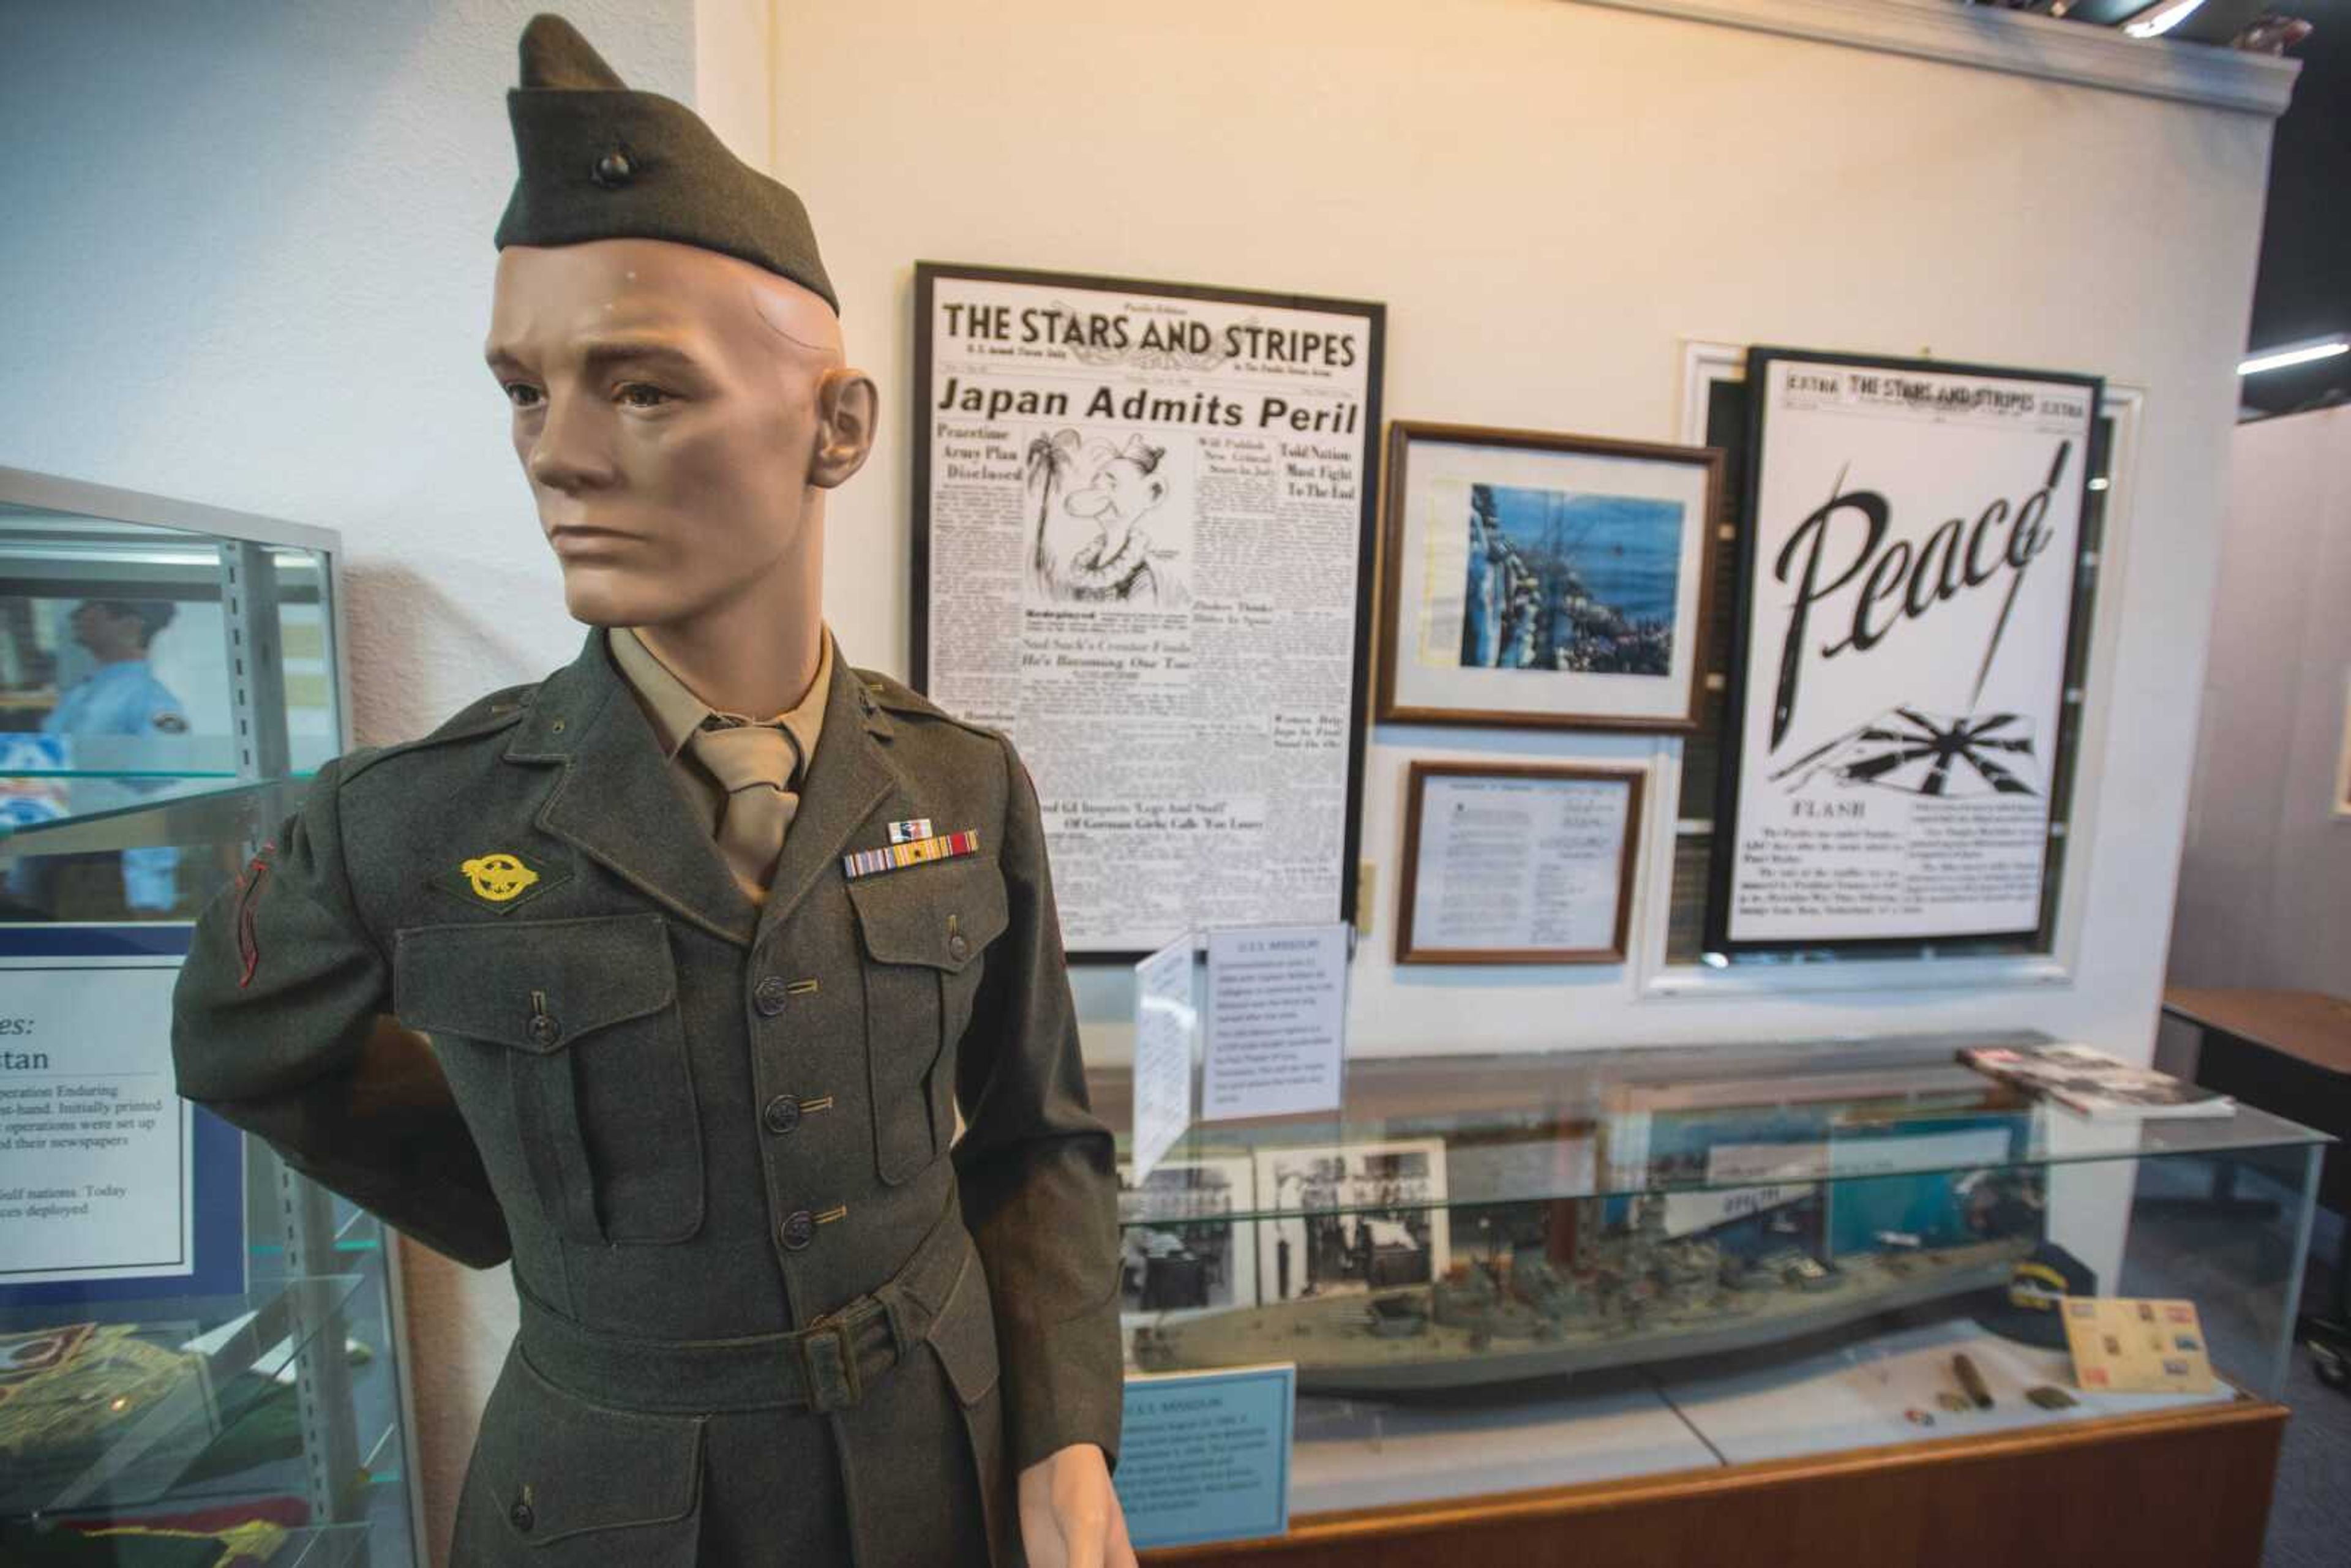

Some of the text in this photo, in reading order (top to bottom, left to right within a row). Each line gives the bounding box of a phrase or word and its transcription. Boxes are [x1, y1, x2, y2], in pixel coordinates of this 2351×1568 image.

[942, 303, 1355, 368] THE STARS AND STRIPES
[1787, 373, 2083, 418] EXTRA THE STARS AND STRIPES EXTRA
[938, 377, 1358, 433] Japan Admits Peril
[986, 445, 1018, 460] Plan
[947, 463, 1023, 481] Disclosed
[1022, 653, 1051, 667] He's
[1056, 655, 1123, 669] Becoming
[1793, 800, 1865, 819] FLASH
[0, 1018, 34, 1035] es:
[0, 1051, 48, 1070] tan
[56, 1084, 118, 1099] Enduring
[58, 1101, 109, 1116] Initially
[115, 1100, 162, 1115] printed
[5, 1118, 155, 1136] operations were set up
[15, 1136, 47, 1149] their
[50, 1136, 129, 1151] newspapers
[83, 1184, 127, 1200] Today
[26, 1202, 89, 1219] deployed
